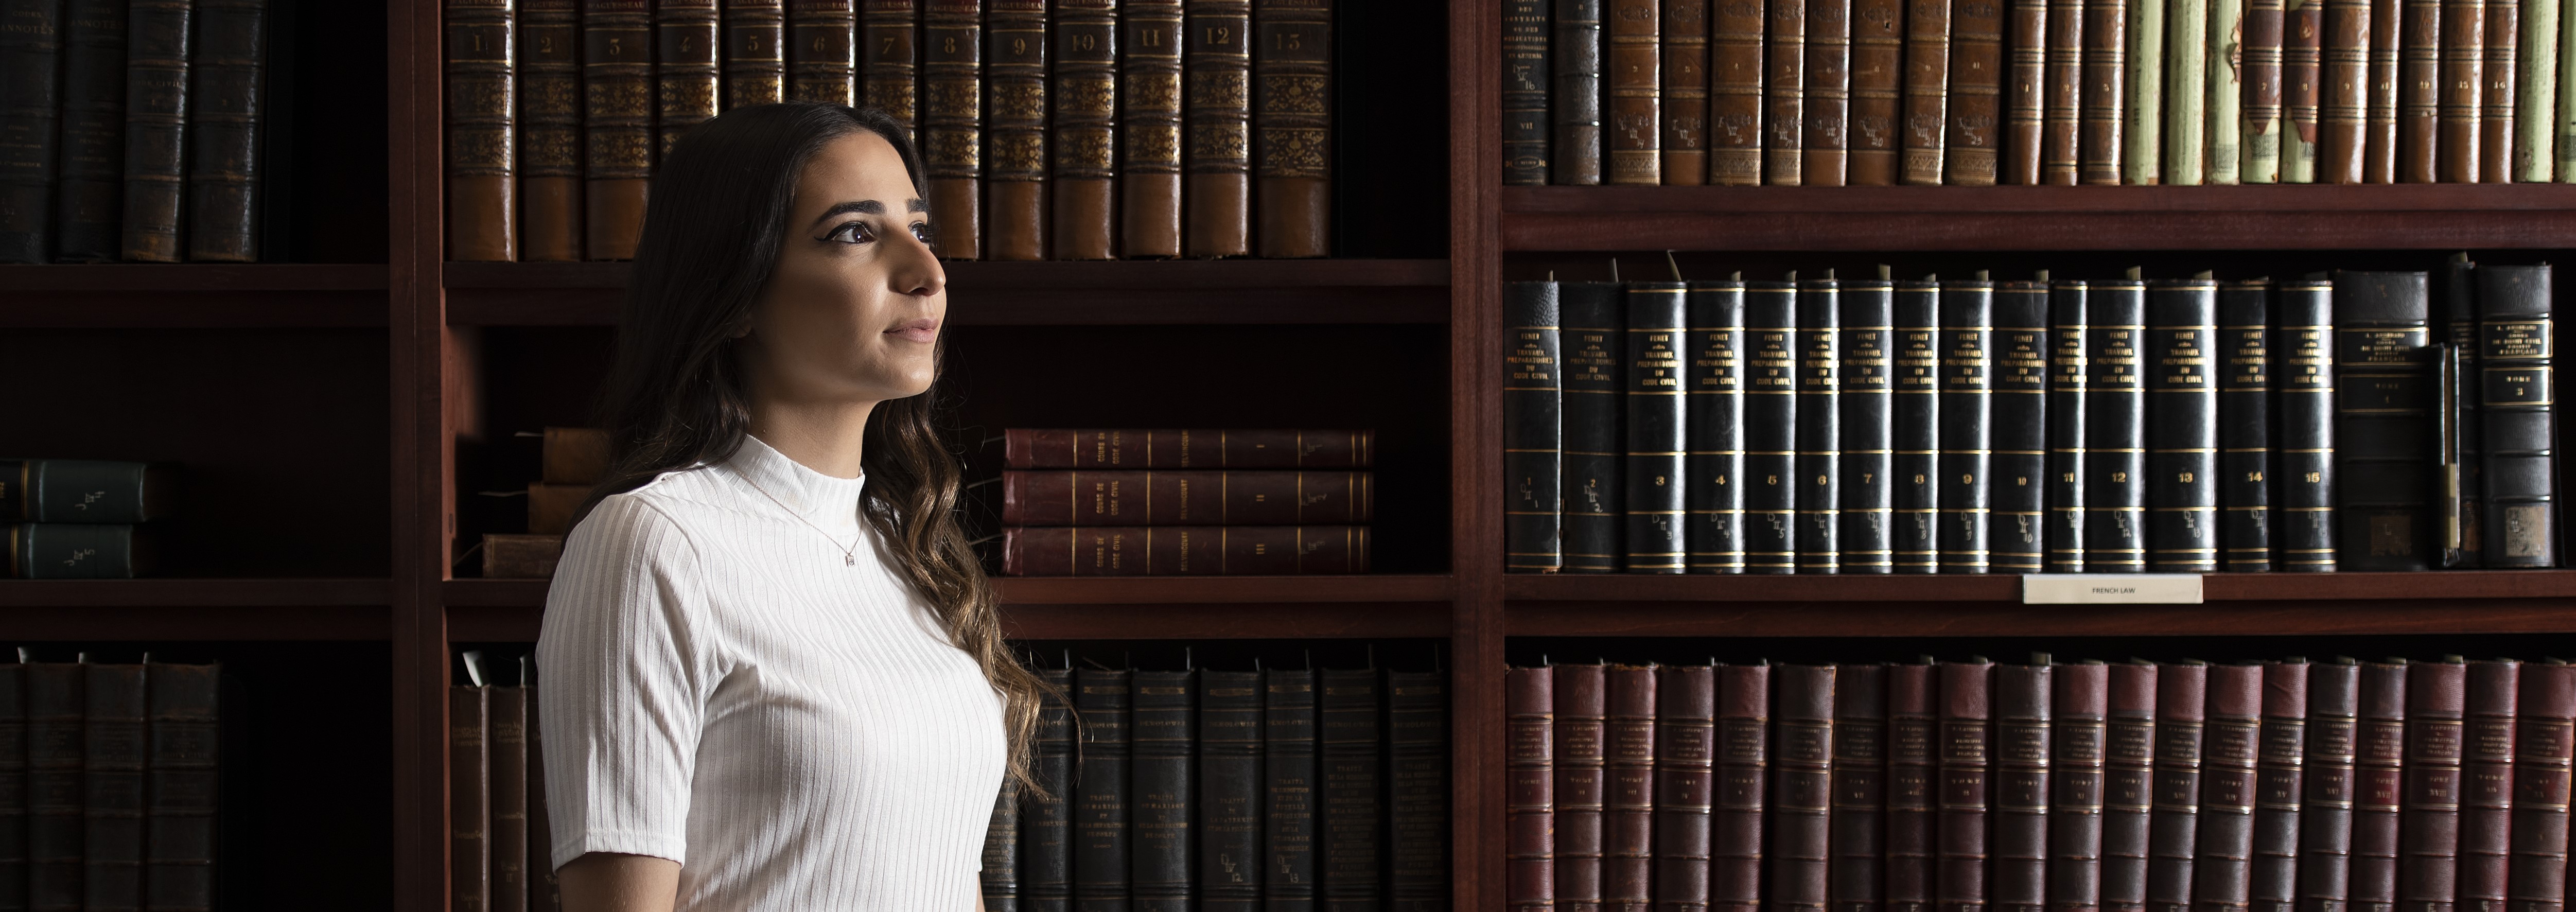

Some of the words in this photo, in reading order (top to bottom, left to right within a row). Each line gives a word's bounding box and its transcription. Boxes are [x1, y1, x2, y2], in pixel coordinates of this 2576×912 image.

[1142, 29, 1159, 46] 11
[1206, 28, 1230, 44] 12
[1276, 33, 1300, 49] 13
[474, 36, 480, 51] 1
[540, 37, 551, 53] 2
[610, 39, 620, 55] 3
[679, 37, 691, 52] 4
[748, 36, 759, 51] 5
[814, 37, 825, 52] 6
[883, 38, 895, 54] 7
[945, 38, 955, 54] 8
[1014, 39, 1026, 55] 9
[1072, 34, 1095, 51] 10
[1525, 81, 1535, 90] 16
[1656, 476, 1664, 485] 3
[1715, 476, 1726, 485] 4
[1767, 476, 1777, 485] 5
[1817, 476, 1827, 485] 6
[1864, 474, 1872, 483] 7
[1915, 475, 1924, 484] 8
[1962, 475, 1972, 484] 9
[2018, 477, 2026, 485] 10
[2112, 473, 2125, 482] 12
[2179, 473, 2193, 482] 13
[2248, 472, 2262, 482] 14
[2306, 472, 2320, 482] 15
[1256, 543, 1265, 555] III
